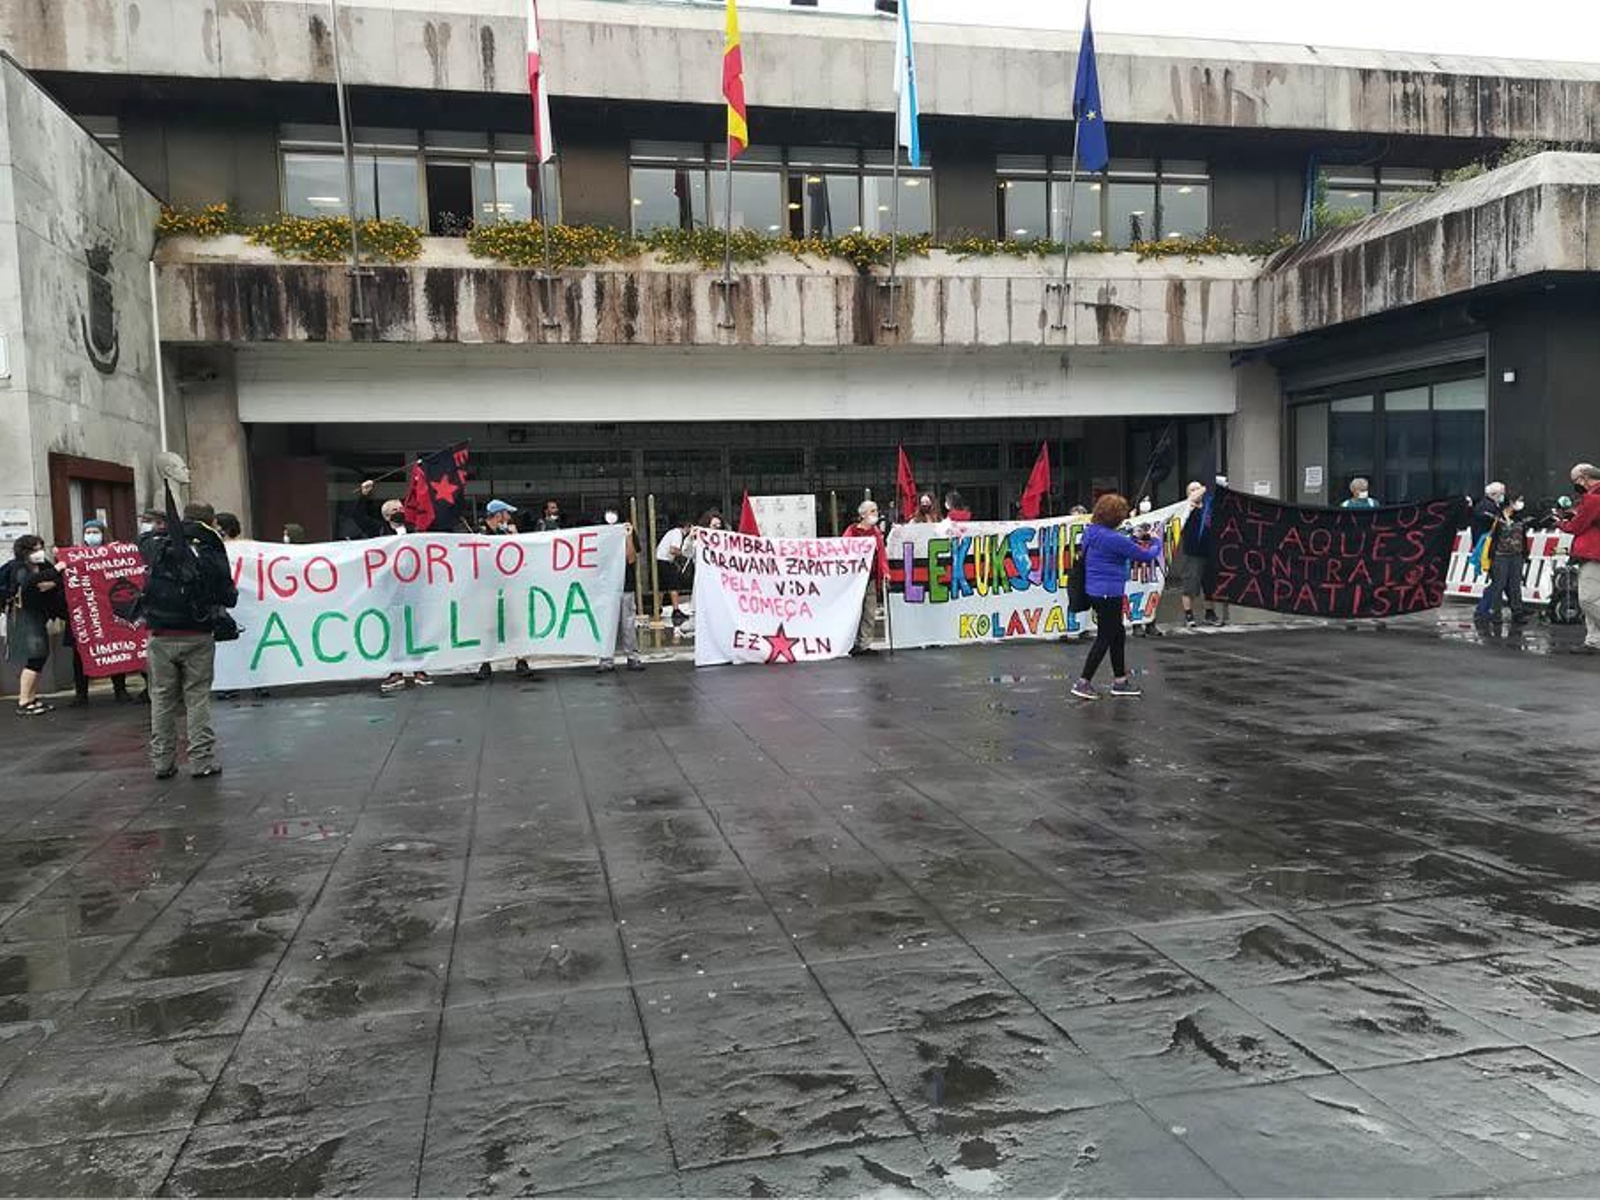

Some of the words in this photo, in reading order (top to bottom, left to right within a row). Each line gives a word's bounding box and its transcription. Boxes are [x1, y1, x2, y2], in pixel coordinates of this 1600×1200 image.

[1219, 516, 1426, 561] ATAQUES
[68, 547, 108, 562] SALUD
[84, 557, 137, 571] IGUALDAD
[364, 542, 525, 589] PORTO
[553, 532, 598, 571] DE
[702, 547, 780, 576] CARAVANA
[785, 557, 868, 577] ZAPATISTA
[1217, 544, 1373, 585] CONTRA
[721, 573, 762, 595] PELA
[775, 580, 820, 597] VIDA
[1211, 572, 1445, 616] ZAPATISTAS
[738, 595, 812, 622] COMEÇA
[250, 582, 601, 671] ACOLLIDA
[89, 640, 137, 656] LIBERTAD
